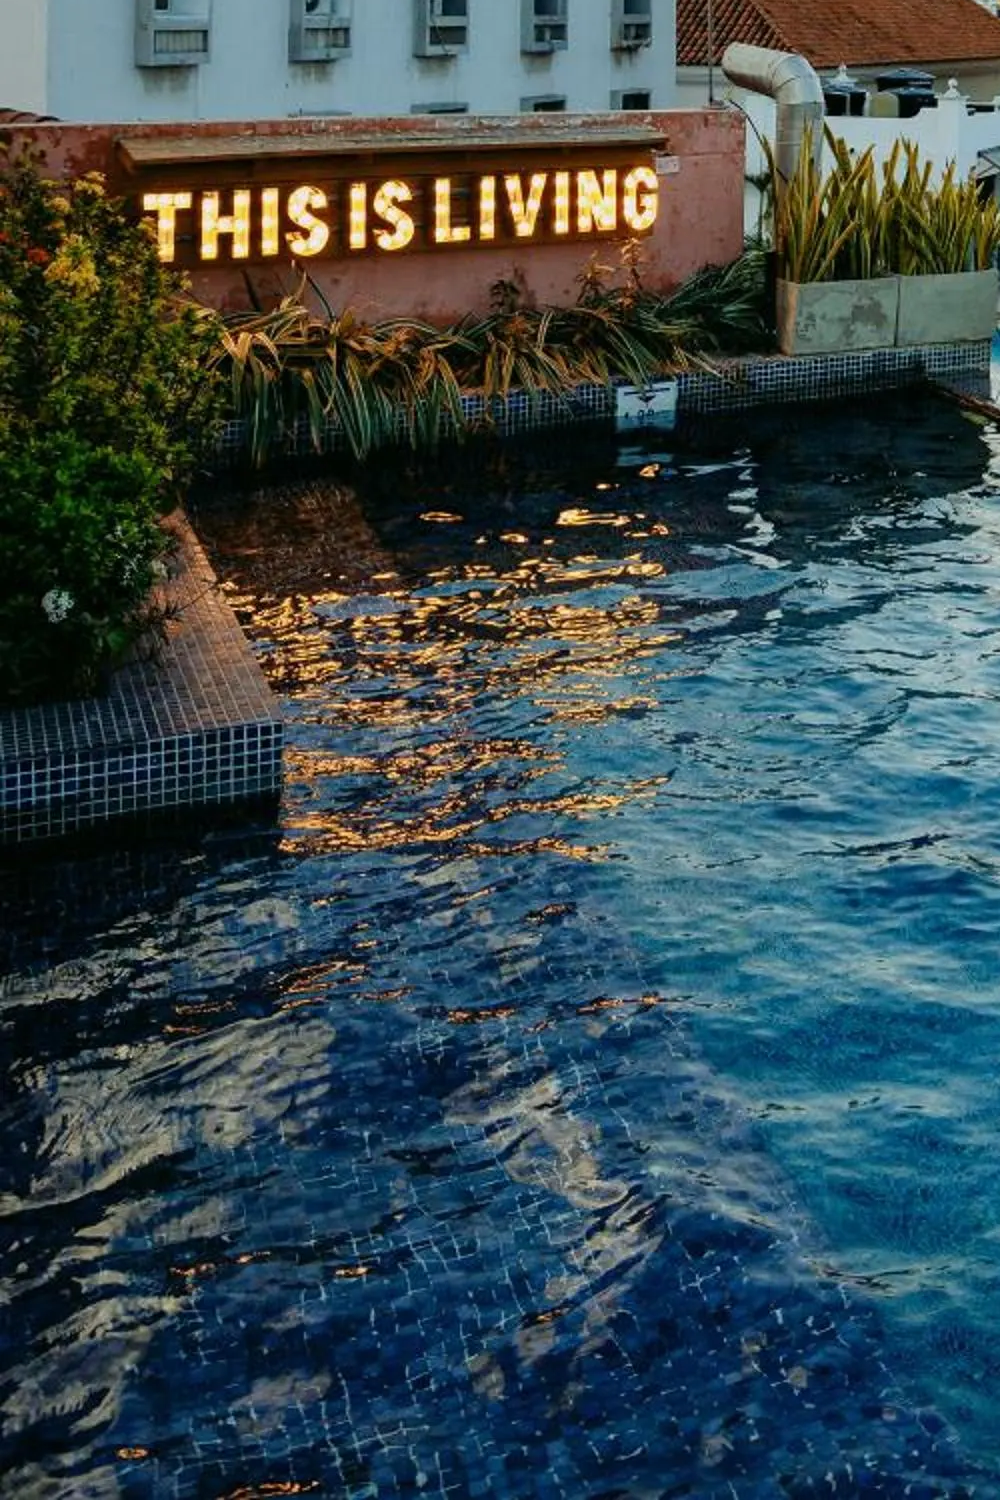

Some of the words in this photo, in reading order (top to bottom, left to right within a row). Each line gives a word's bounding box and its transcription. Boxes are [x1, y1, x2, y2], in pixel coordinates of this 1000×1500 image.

[142, 185, 329, 262] THIS
[348, 180, 416, 251] IS
[434, 166, 659, 243] LIVING
